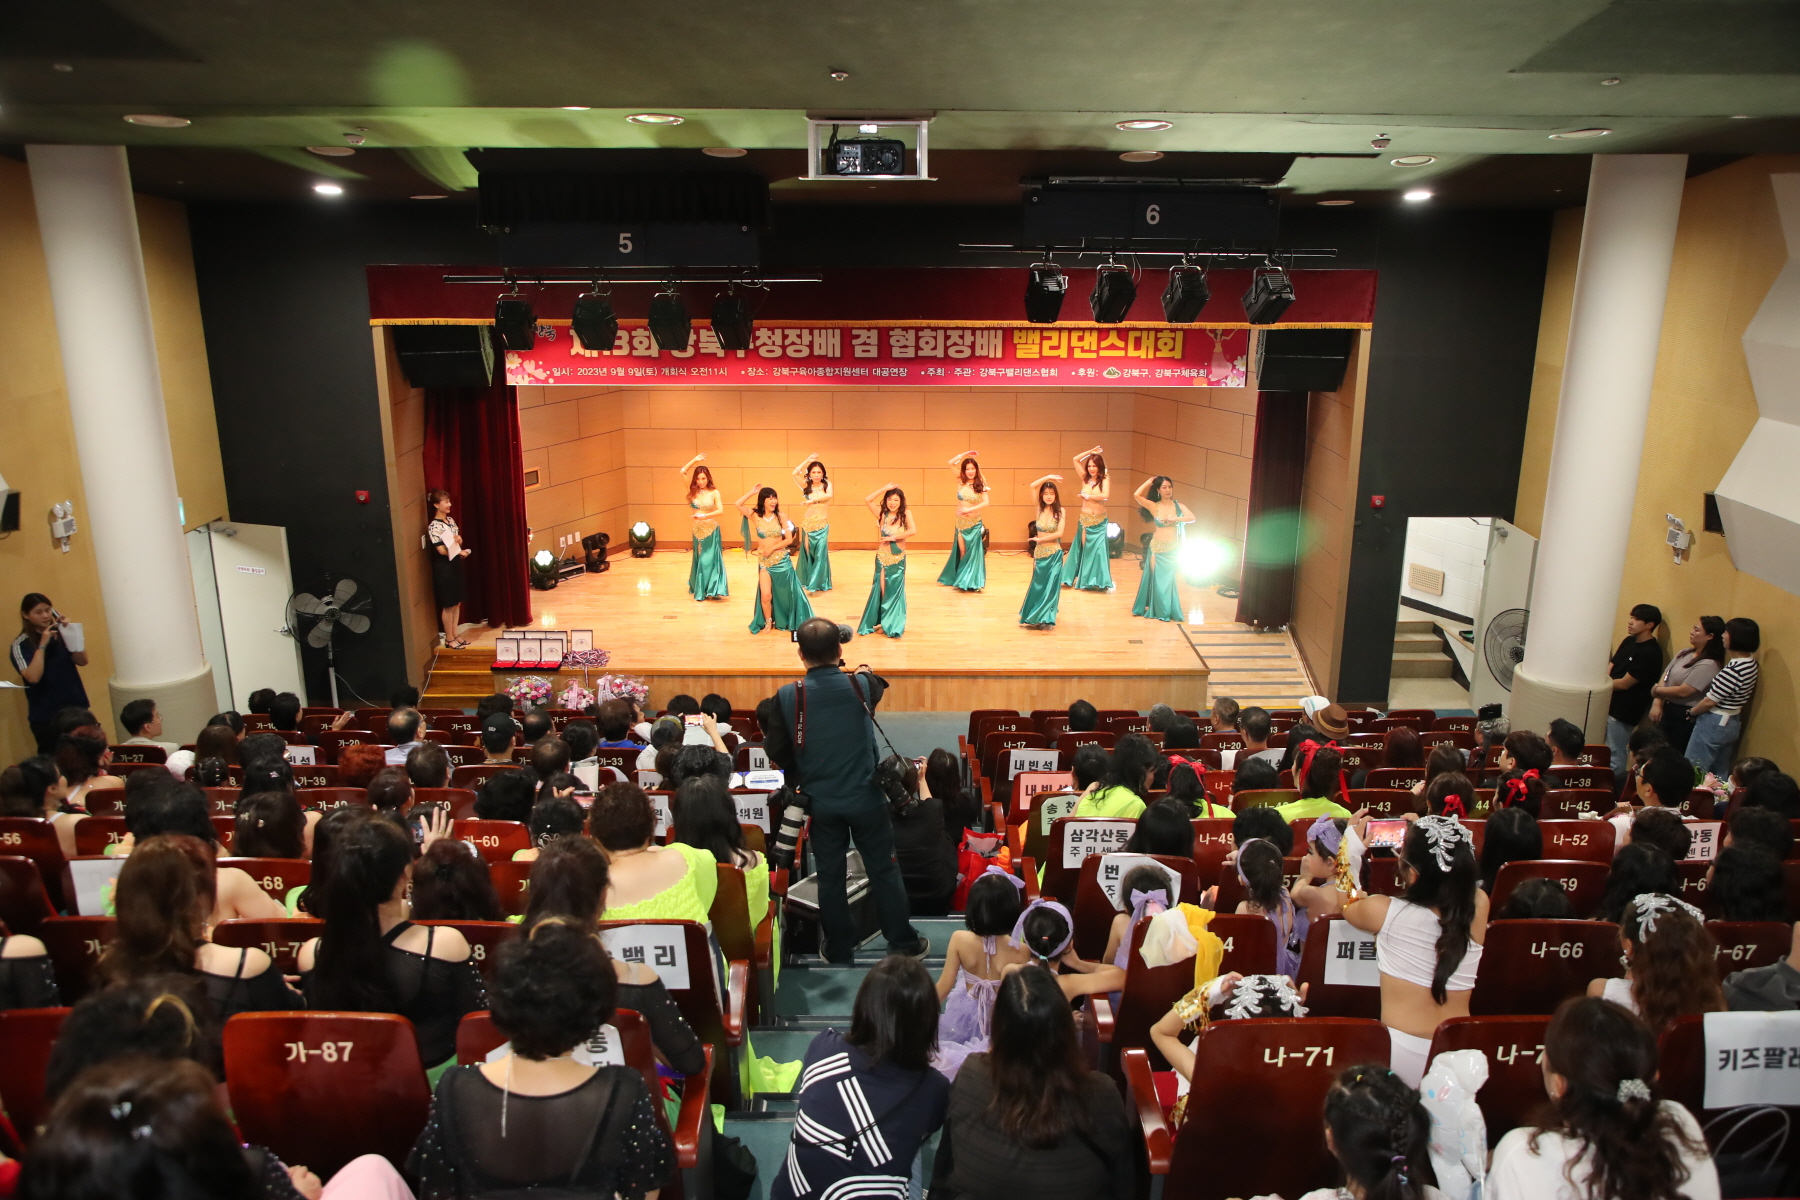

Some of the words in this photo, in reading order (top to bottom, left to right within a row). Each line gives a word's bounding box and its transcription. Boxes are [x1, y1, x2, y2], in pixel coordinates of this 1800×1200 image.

[1146, 204, 1160, 225] 6
[619, 232, 633, 254] 5
[569, 328, 659, 357] 제3회
[670, 328, 841, 358] 북청장배
[851, 328, 879, 358] 겸
[888, 328, 1003, 359] 협회장배
[1012, 328, 1184, 359] 밸리댄스대회
[552, 367, 574, 377] 일시:
[577, 367, 608, 377] 2023년
[610, 367, 625, 377] 9월
[628, 367, 658, 377] 9일(토)
[661, 367, 687, 377] 개회식
[690, 367, 728, 377] 오전11시
[747, 367, 769, 377] 장소:
[772, 367, 869, 378] 강북구육아종합지원센터
[872, 367, 908, 378] 대공연장
[927, 368, 945, 378] 주최
[954, 368, 976, 378] 주관:
[980, 368, 1058, 378] 강북구밸리댄스협회
[1077, 368, 1099, 378] 후원:
[1155, 368, 1207, 378] 강북구체육회
[1004, 741, 1026, 749] 나-17
[120, 754, 144, 762] 가-27
[598, 757, 623, 766] 가-33
[1577, 754, 1593, 762] -31
[299, 776, 326, 786] 가-39
[1391, 780, 1417, 788] 나-36
[1565, 778, 1591, 787] 나-38
[1361, 801, 1391, 812] 나-43
[1476, 800, 1489, 810] 44
[1560, 801, 1591, 811] 나-45
[0, 833, 22, 845] -56
[1070, 829, 1128, 844] 삼각산동
[1200, 833, 1234, 845] 나-49
[1553, 834, 1589, 846] 나-52
[256, 876, 284, 889] -68
[1282, 875, 1300, 888] 57
[1559, 878, 1578, 891] 59
[1531, 942, 1584, 958] 나-66
[285, 1041, 354, 1062] 가-87
[1263, 1047, 1335, 1067] 나-71
[1497, 1044, 1545, 1065] 나-7
